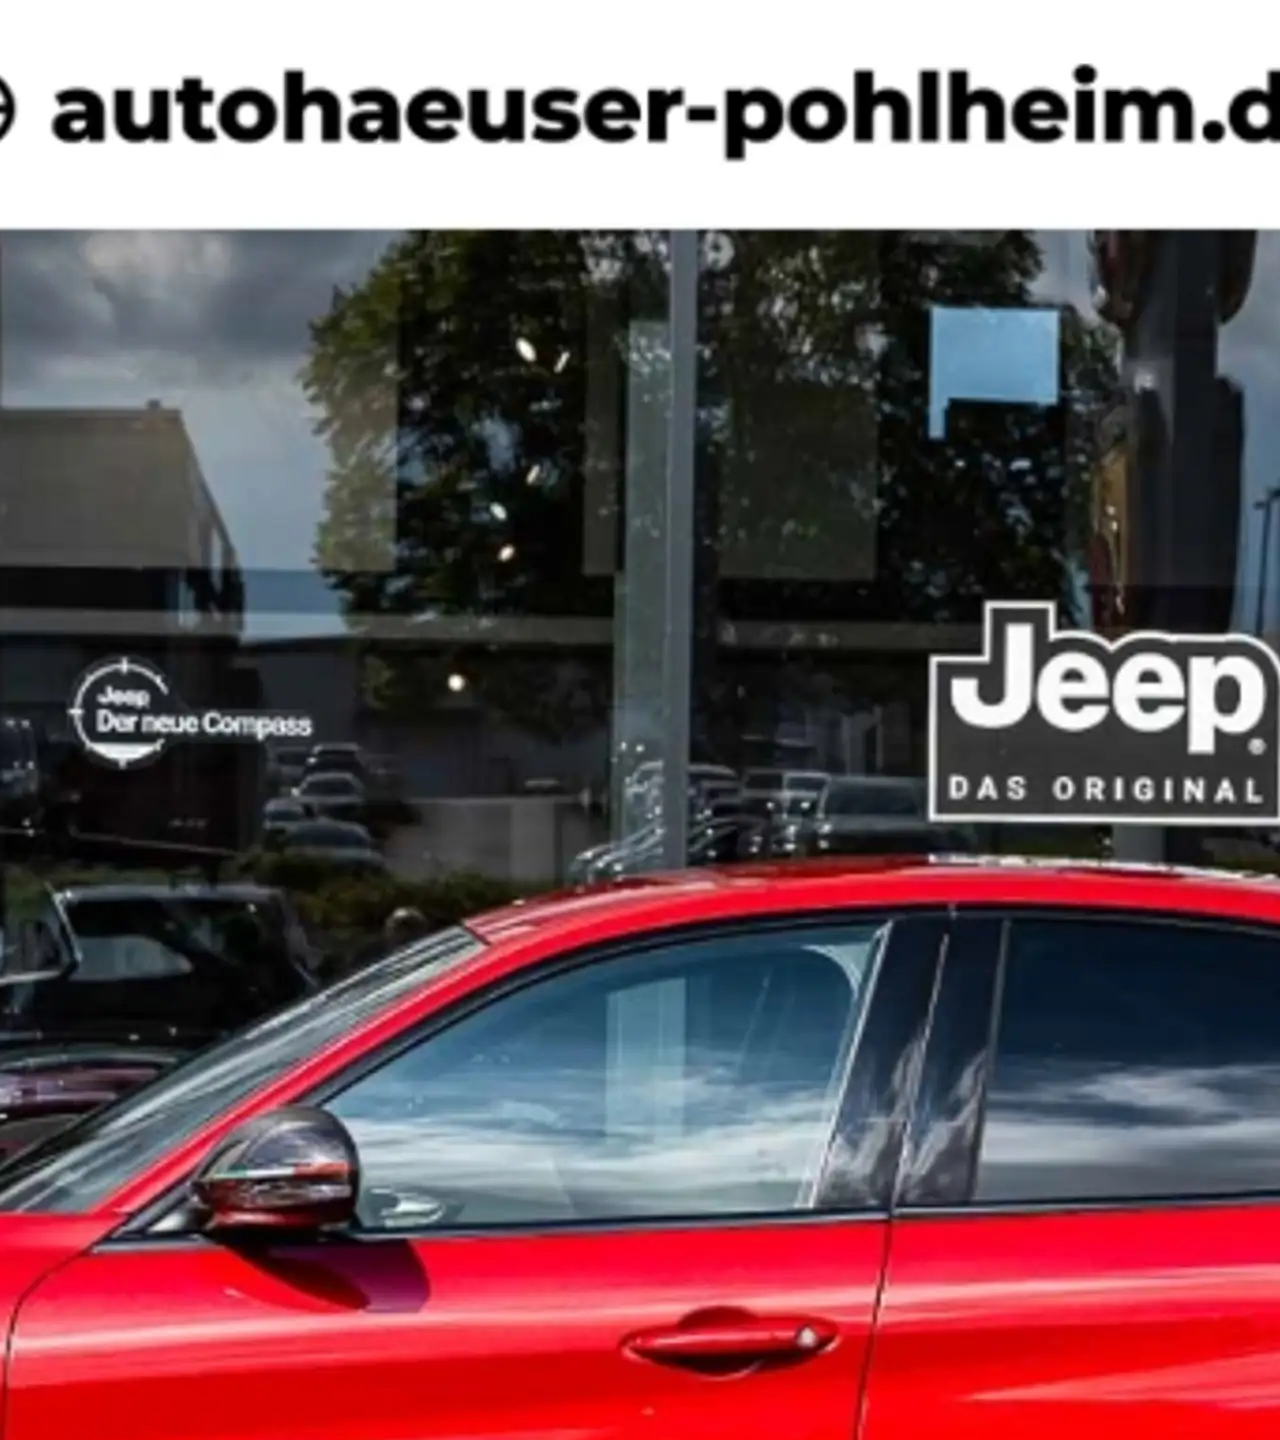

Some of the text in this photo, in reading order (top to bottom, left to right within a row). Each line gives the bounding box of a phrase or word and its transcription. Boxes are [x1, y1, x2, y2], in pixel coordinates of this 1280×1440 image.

[96, 686, 150, 708] Jeep
[950, 622, 1266, 755] Jeep
[96, 709, 313, 741] Der neue Compass
[948, 775, 1265, 804] DAS ORIGINAL
